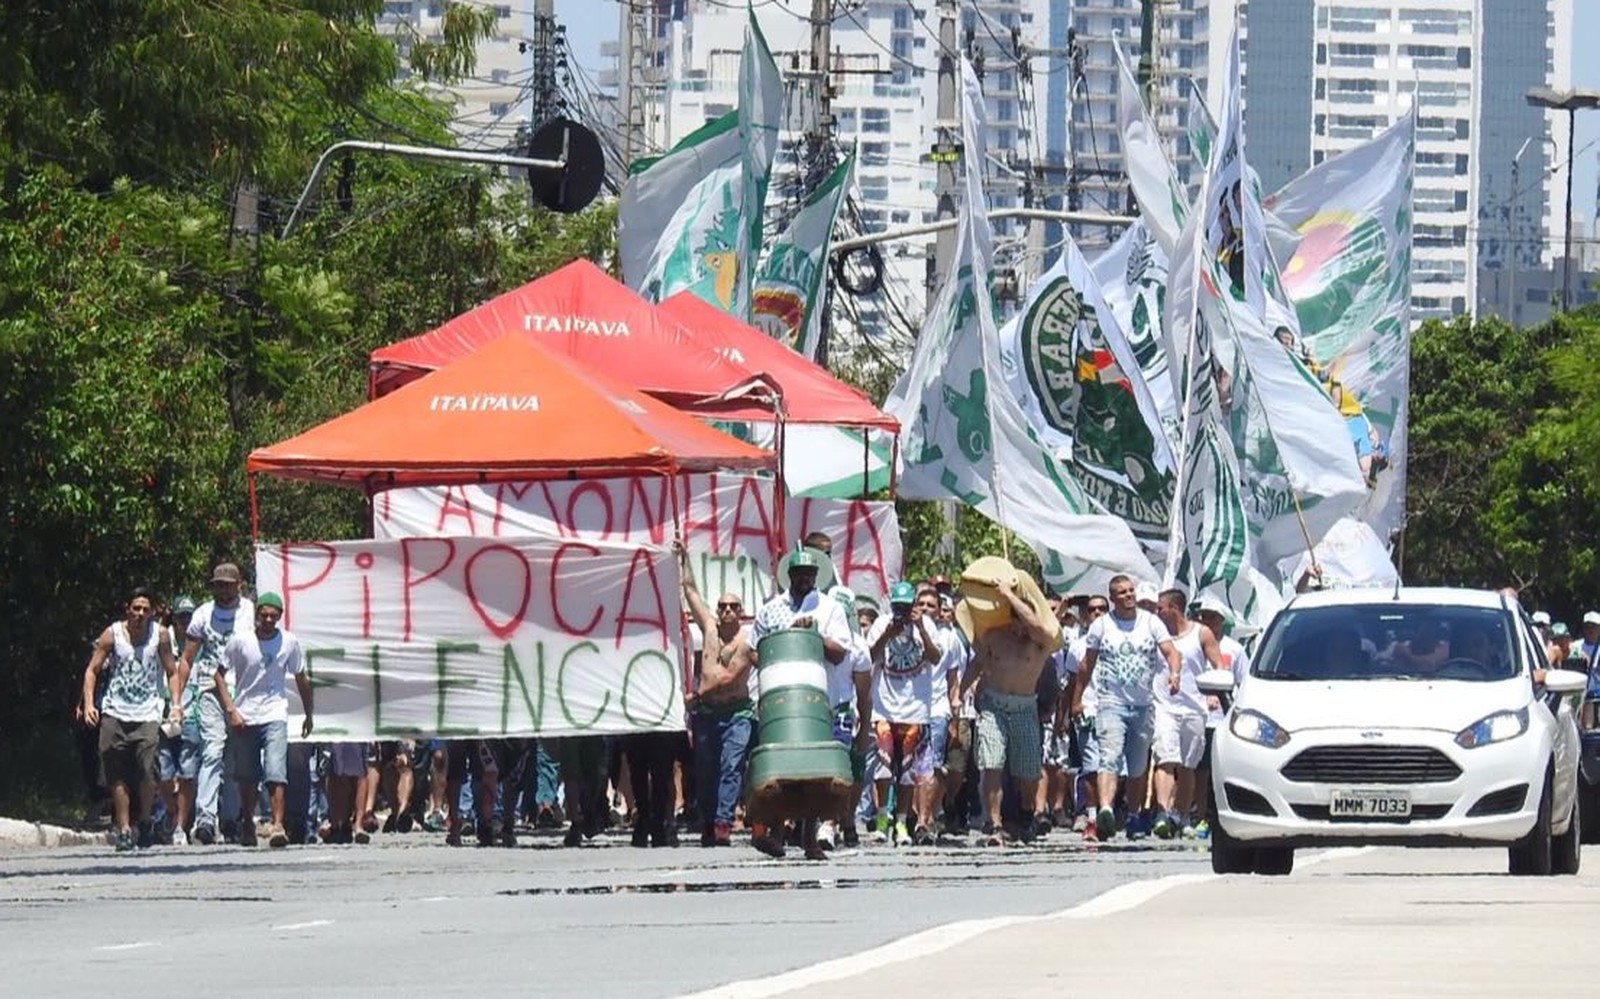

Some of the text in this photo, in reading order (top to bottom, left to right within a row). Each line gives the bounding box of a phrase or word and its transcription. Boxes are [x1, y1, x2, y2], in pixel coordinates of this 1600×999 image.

[523, 313, 631, 338] ITAIPAVA
[429, 393, 540, 412] ITAIPAVA
[306, 640, 677, 738] ELENCO
[1369, 798, 1408, 814] 7033
